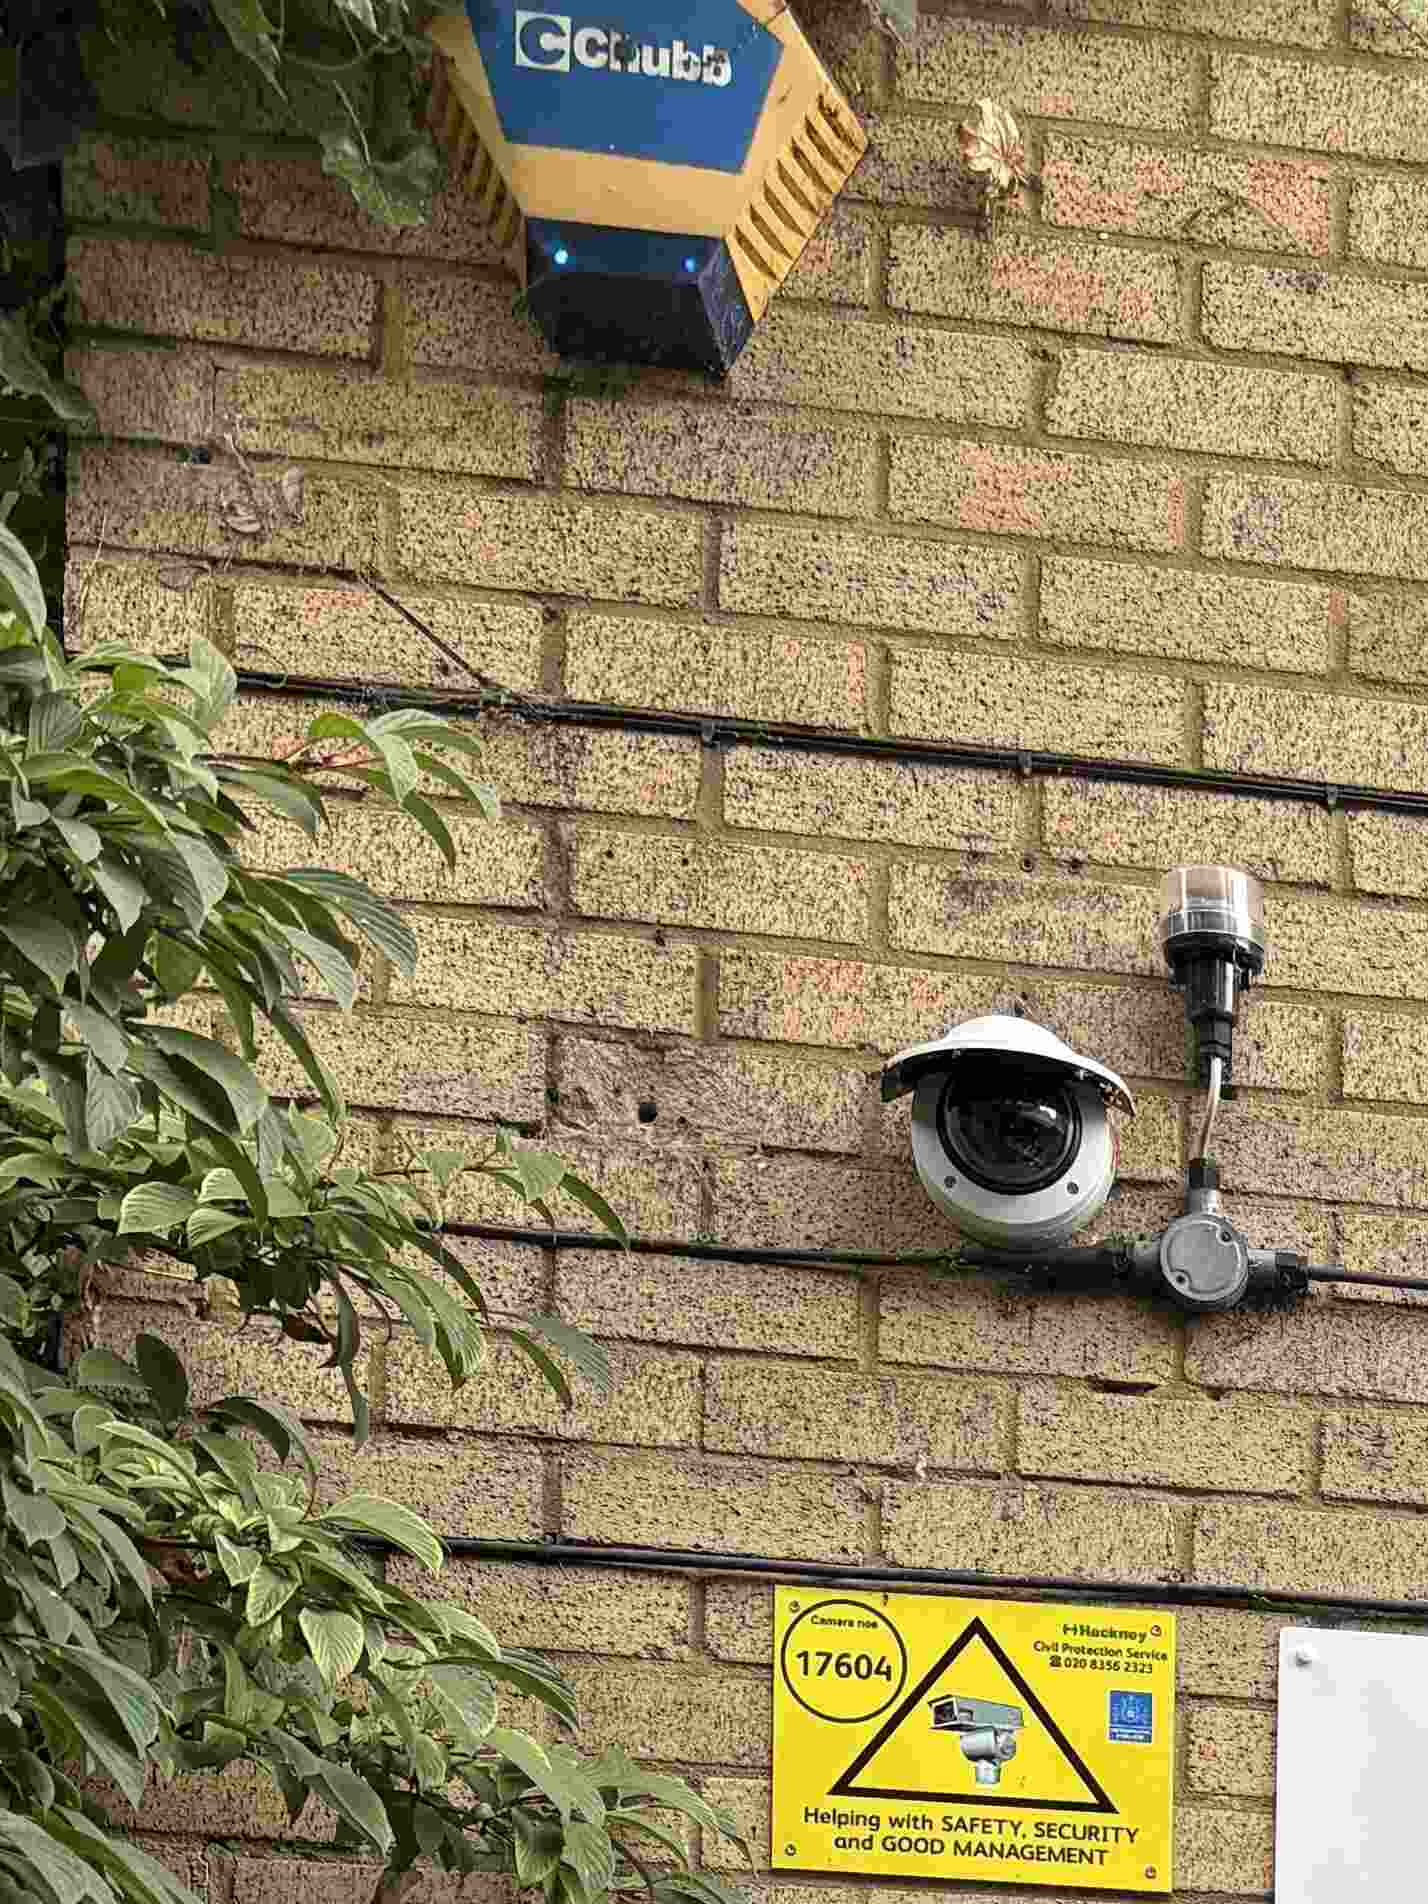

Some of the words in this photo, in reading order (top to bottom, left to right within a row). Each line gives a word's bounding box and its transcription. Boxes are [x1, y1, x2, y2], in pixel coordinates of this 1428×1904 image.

[1078, 1624, 1147, 1643] Hackney
[1033, 1640, 1058, 1652] Civil
[1061, 1643, 1122, 1657] Protection
[1126, 1648, 1168, 1661] Service
[1064, 1657, 1087, 1669] 020
[797, 1650, 892, 1682] 17604
[803, 1806, 880, 1830] Helping
[888, 1812, 933, 1831] with
[1033, 1822, 1139, 1844] SECURITY
[833, 1835, 873, 1850] and
[881, 1836, 945, 1855] GOOD
[953, 1840, 1109, 1865] MANAGEMENT
